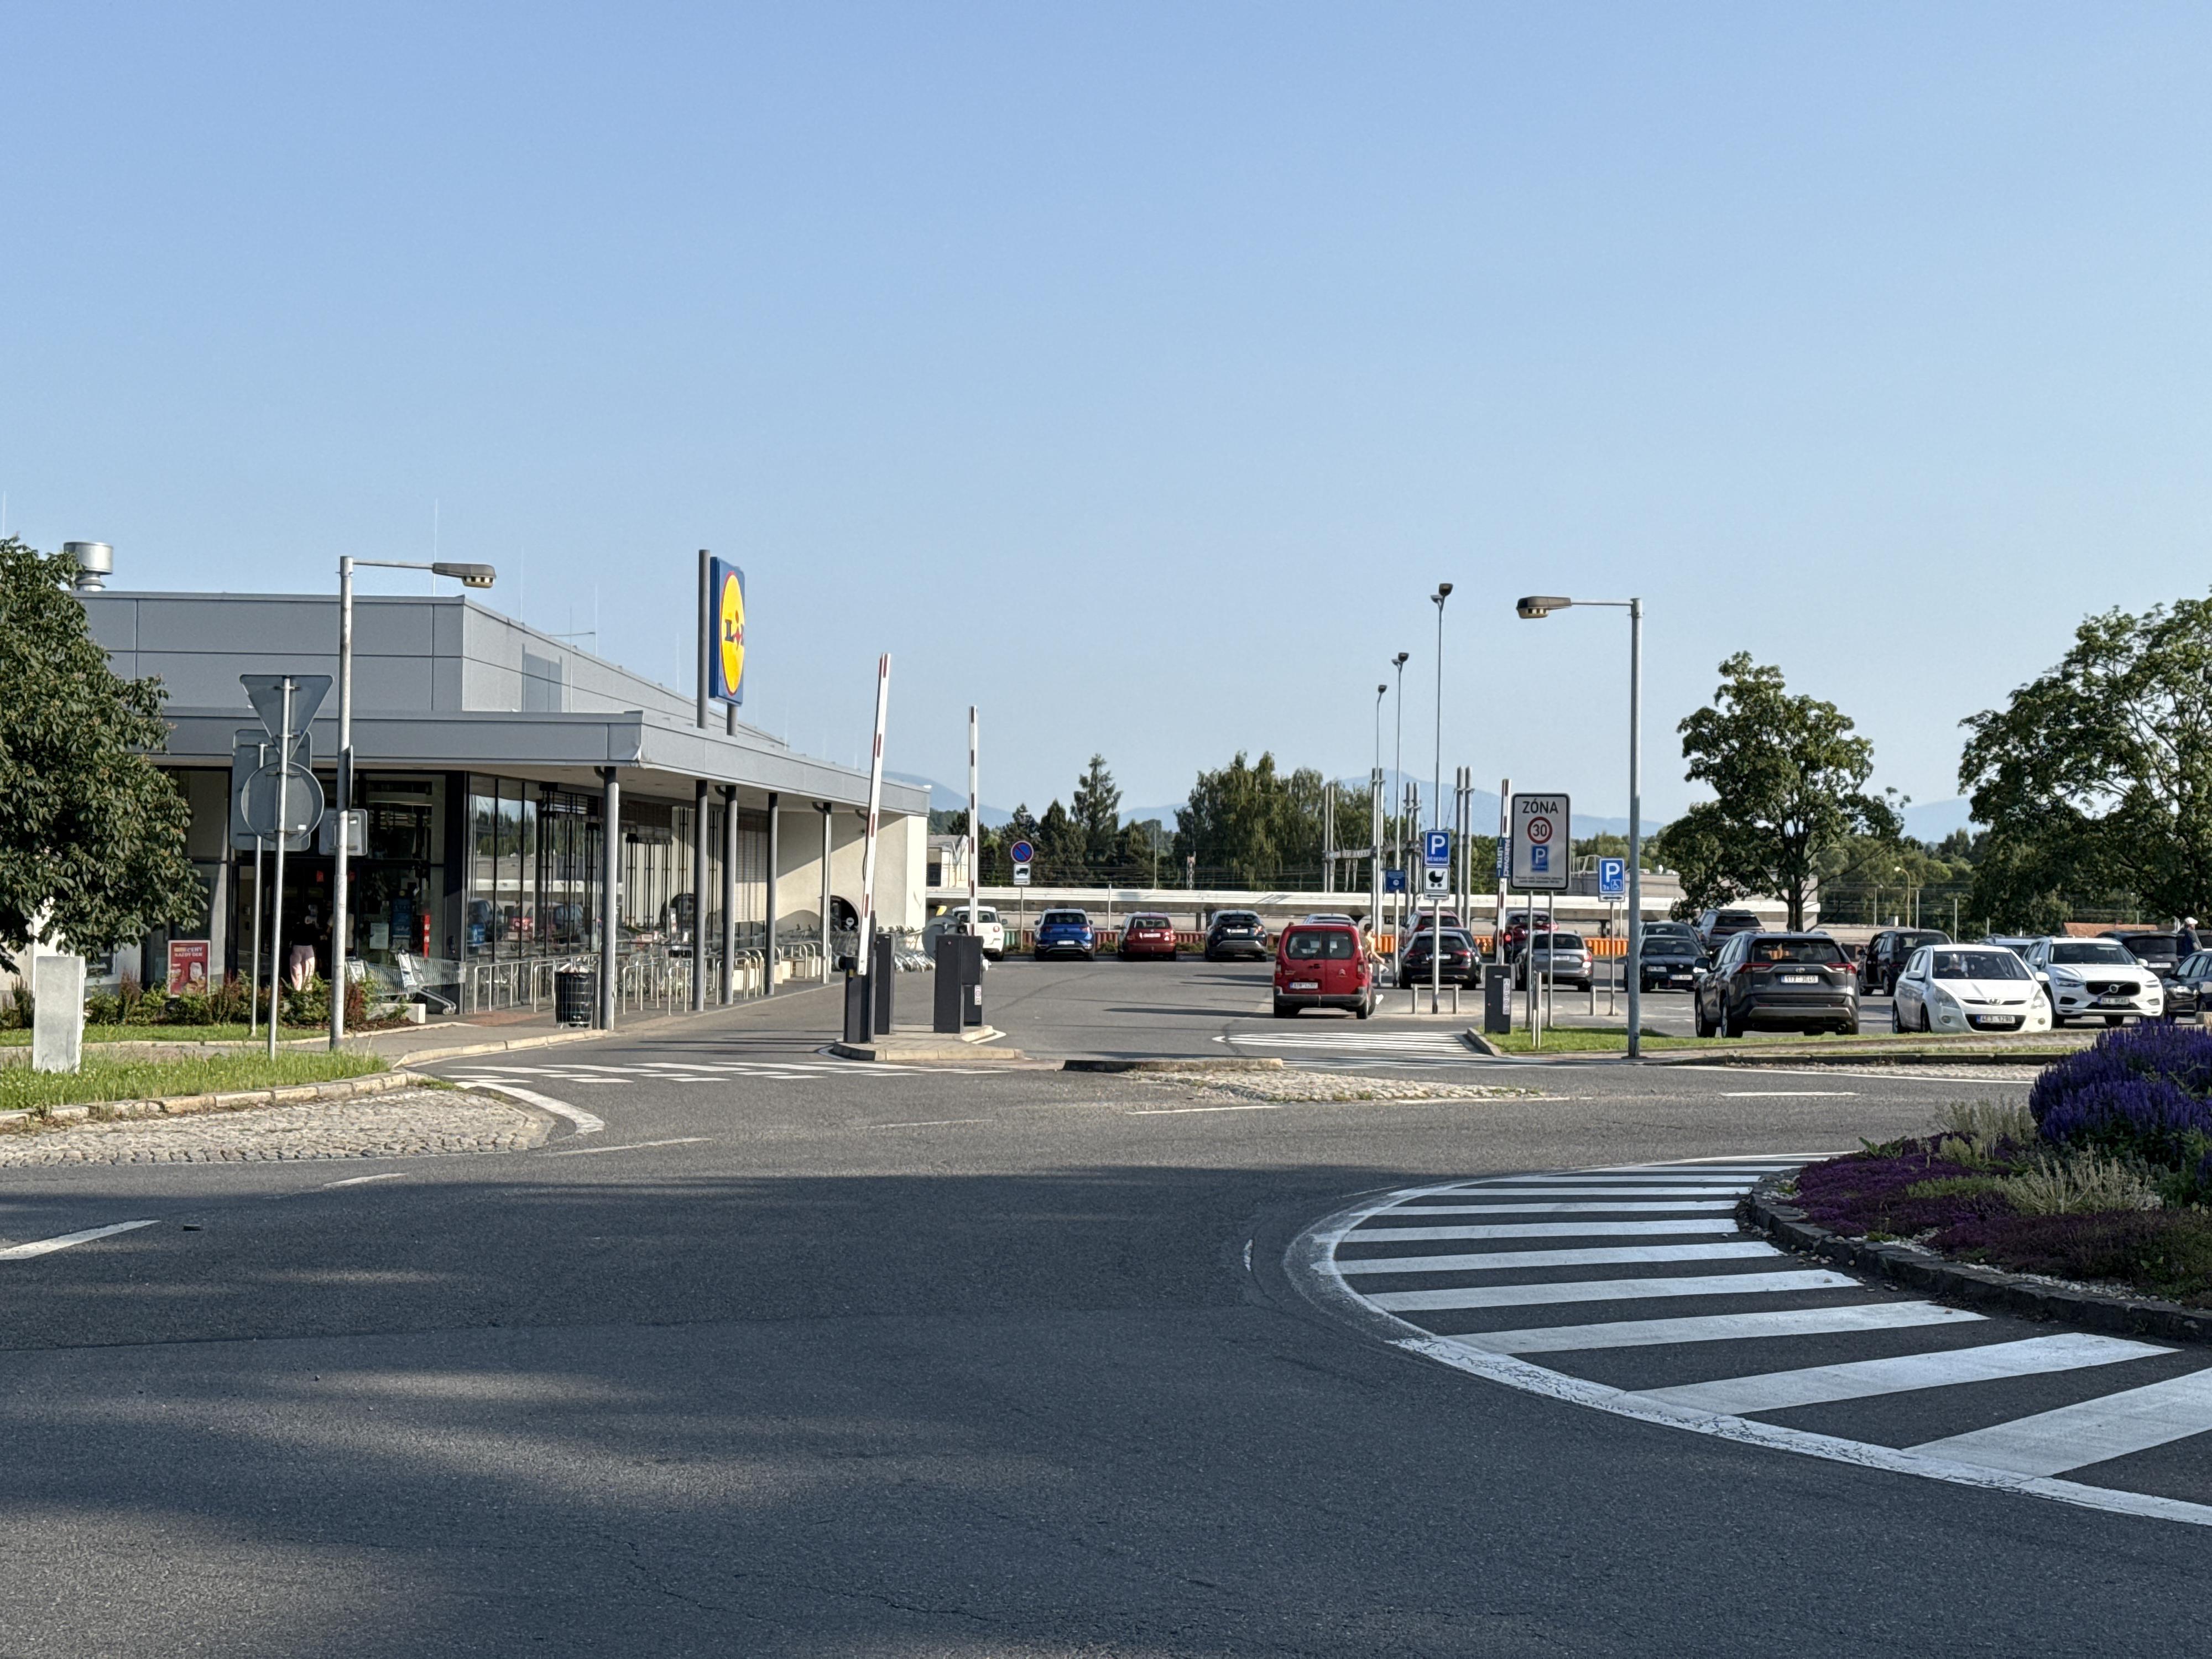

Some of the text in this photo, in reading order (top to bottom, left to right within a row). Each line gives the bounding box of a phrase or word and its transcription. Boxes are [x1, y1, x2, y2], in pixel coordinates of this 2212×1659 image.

[1522, 798, 1559, 814] ZÓNA
[1532, 824, 1547, 837] 30
[1431, 835, 1446, 854] P
[1535, 848, 1546, 863] P
[1606, 862, 1620, 883] P
